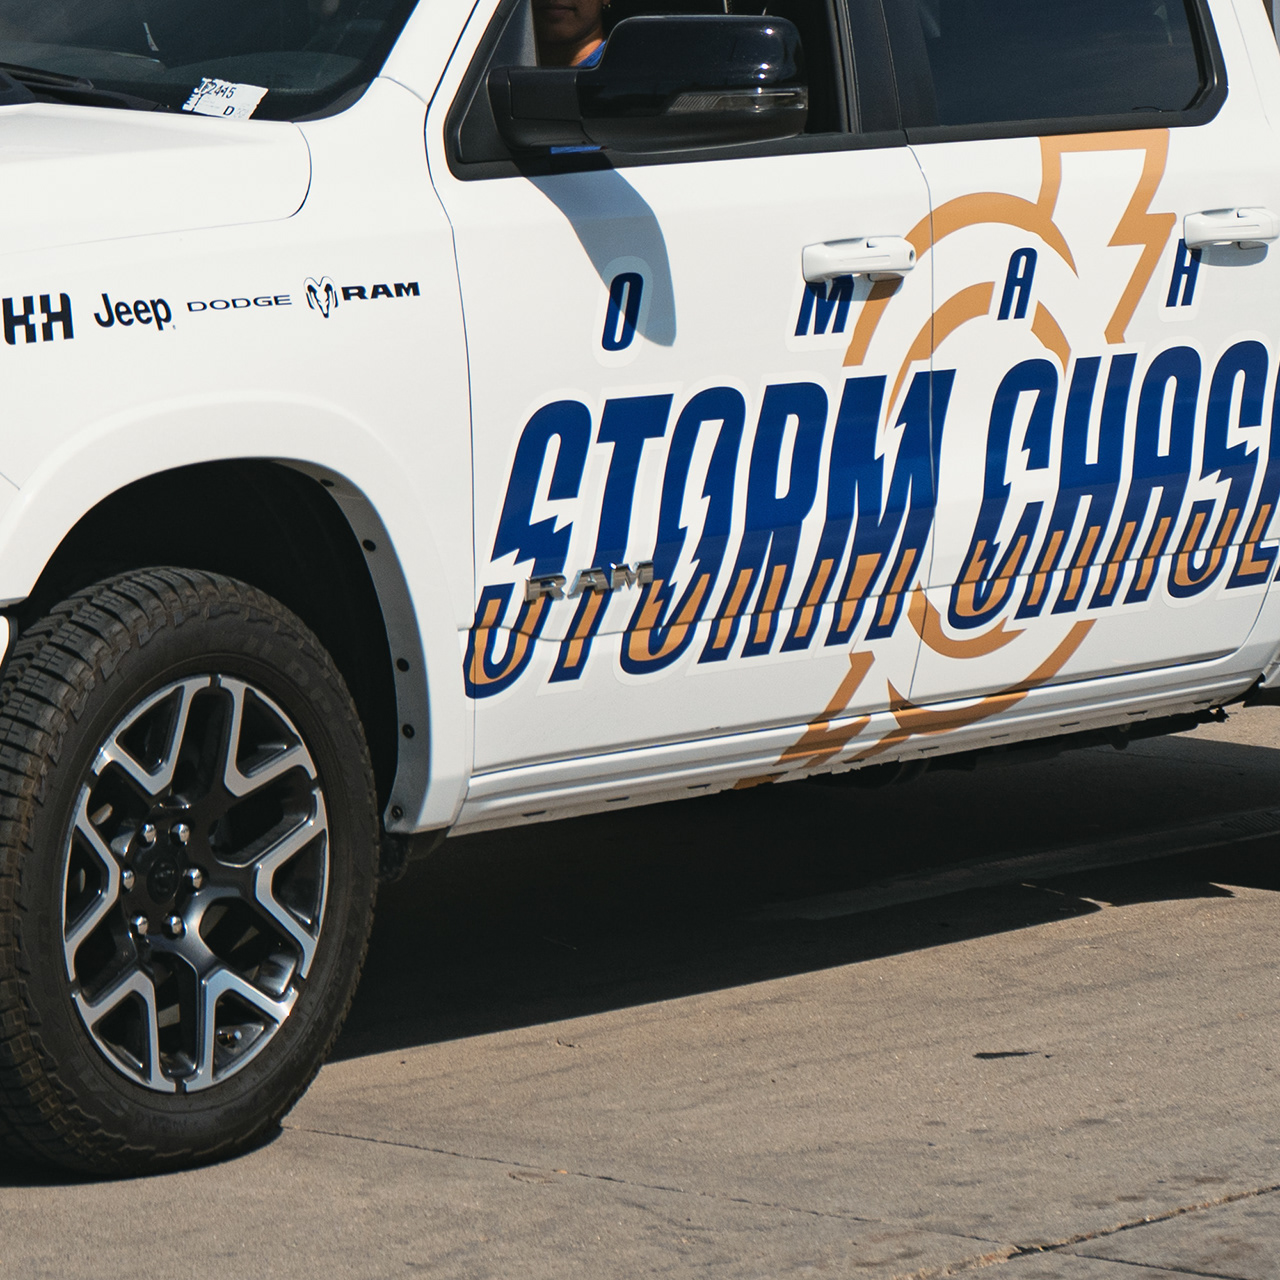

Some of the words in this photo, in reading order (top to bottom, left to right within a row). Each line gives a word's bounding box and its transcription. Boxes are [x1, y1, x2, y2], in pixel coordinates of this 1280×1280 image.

[93, 292, 173, 331] Jeep
[186, 294, 293, 312] DODGE
[341, 281, 421, 302] RAM
[463, 368, 956, 700] STORM
[525, 559, 655, 603] RAM
